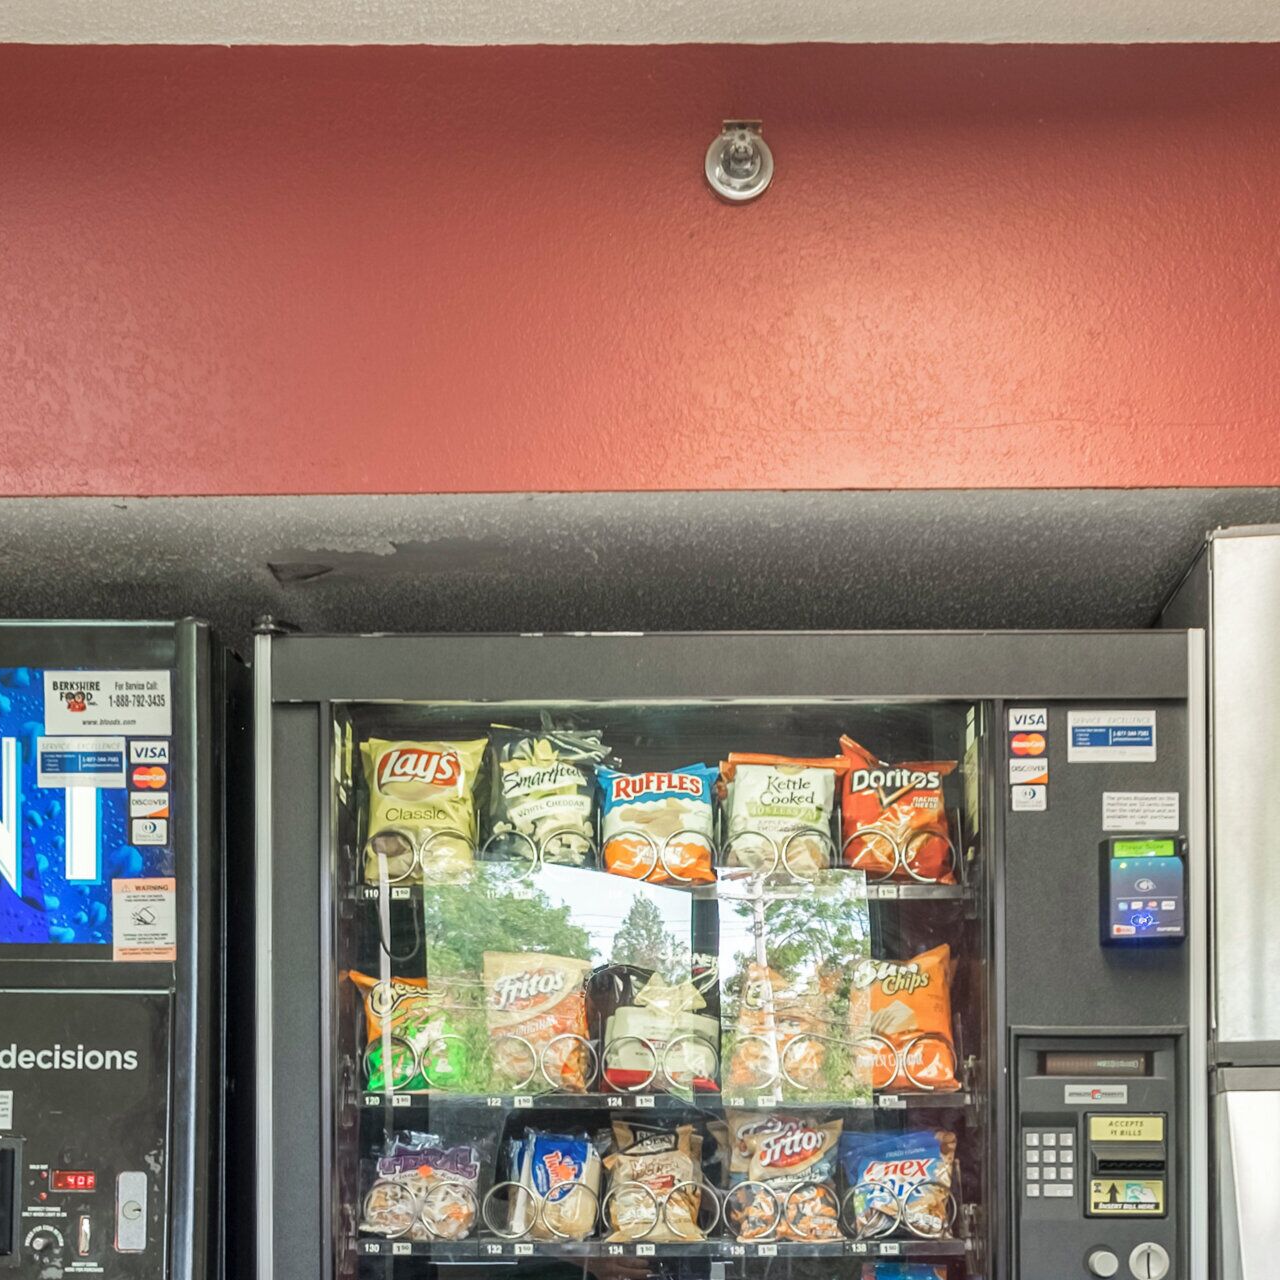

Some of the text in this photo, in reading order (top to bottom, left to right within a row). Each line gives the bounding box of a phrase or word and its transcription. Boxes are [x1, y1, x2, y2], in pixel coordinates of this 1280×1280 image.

[52, 680, 100, 691] BERKSHIRE
[115, 681, 124, 690] For
[125, 681, 145, 690] Service
[1014, 714, 1045, 725] VISA
[135, 747, 166, 758] VISA
[380, 749, 457, 785] Lay's
[613, 771, 703, 799] RUFFLES
[766, 775, 812, 791] Kettle
[851, 769, 941, 793] Doritos
[132, 798, 167, 806] DISCOVER
[760, 791, 815, 806] Cooked
[385, 806, 449, 822] Classic
[364, 888, 379, 897] 110
[853, 959, 919, 989] Sun
[494, 967, 564, 1006] Fritos
[881, 972, 930, 995] Chips
[486, 1097, 501, 1106] 122
[608, 1097, 622, 1107] 124
[1108, 1120, 1144, 1128] ACCEPTS
[760, 1129, 825, 1167] Fritos
[1098, 1202, 1122, 1210] INSERT
